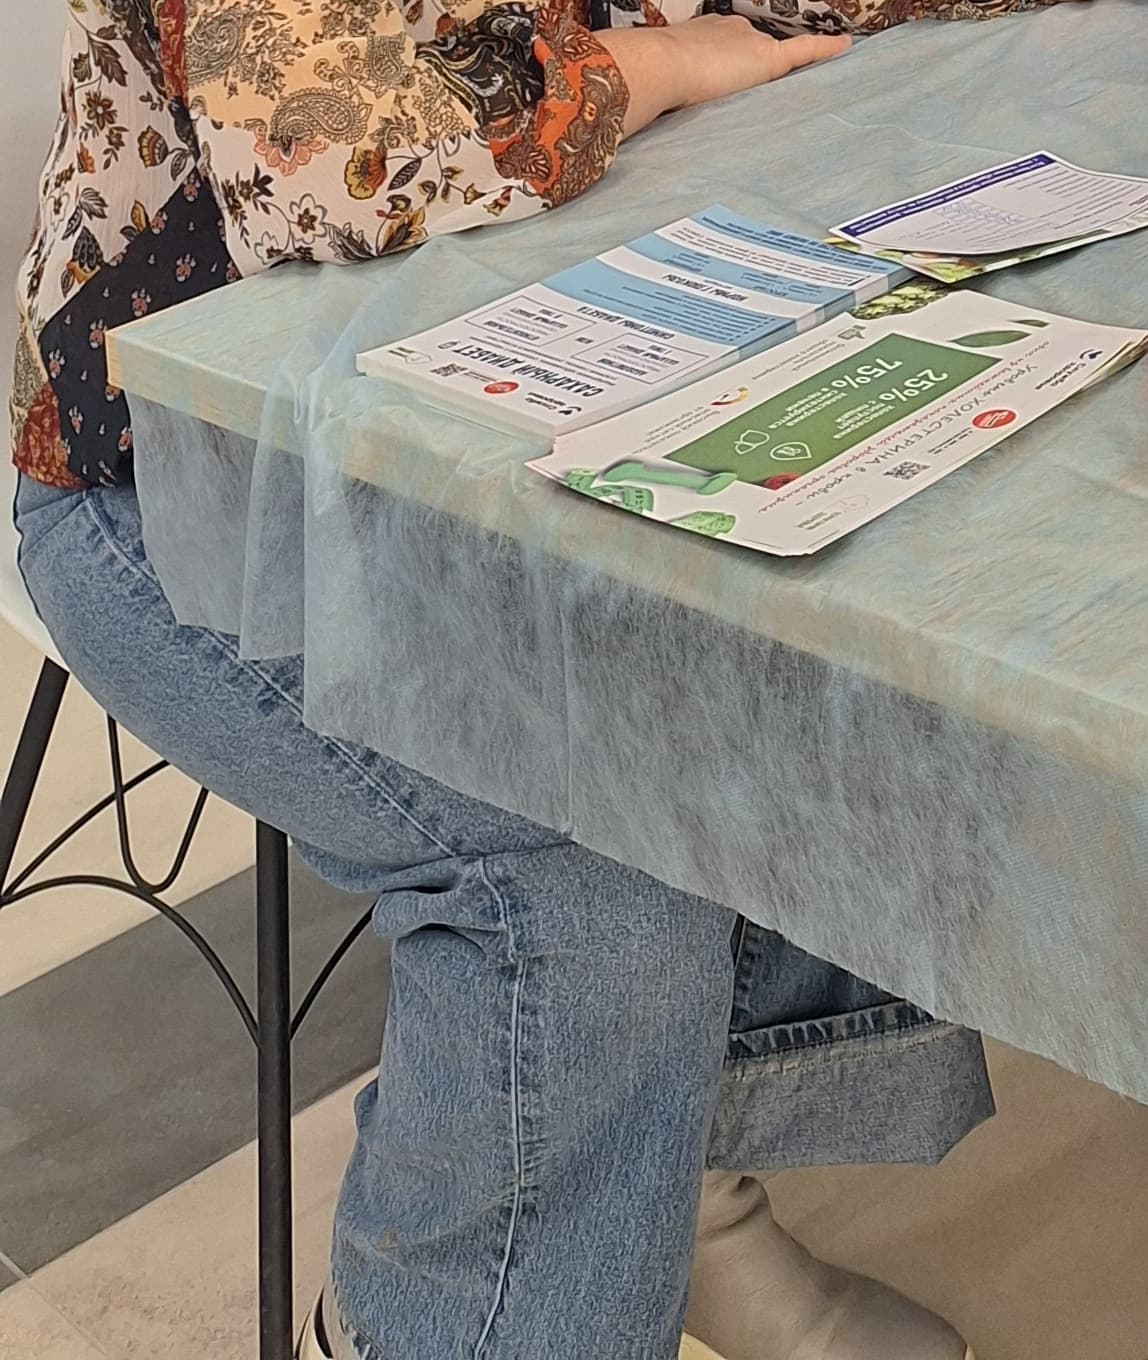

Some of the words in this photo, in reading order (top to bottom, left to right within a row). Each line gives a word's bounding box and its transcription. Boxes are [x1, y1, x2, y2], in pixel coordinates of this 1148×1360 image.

[451, 345, 525, 369] ДИАБЕТ
[828, 356, 903, 392] 75%
[510, 364, 605, 398] САХАРНЫЙ
[876, 368, 950, 404] 25%
[976, 363, 1039, 397] Уровень
[864, 397, 986, 466] ХОЛЕСТЕРИНА
[802, 472, 856, 500] крови
